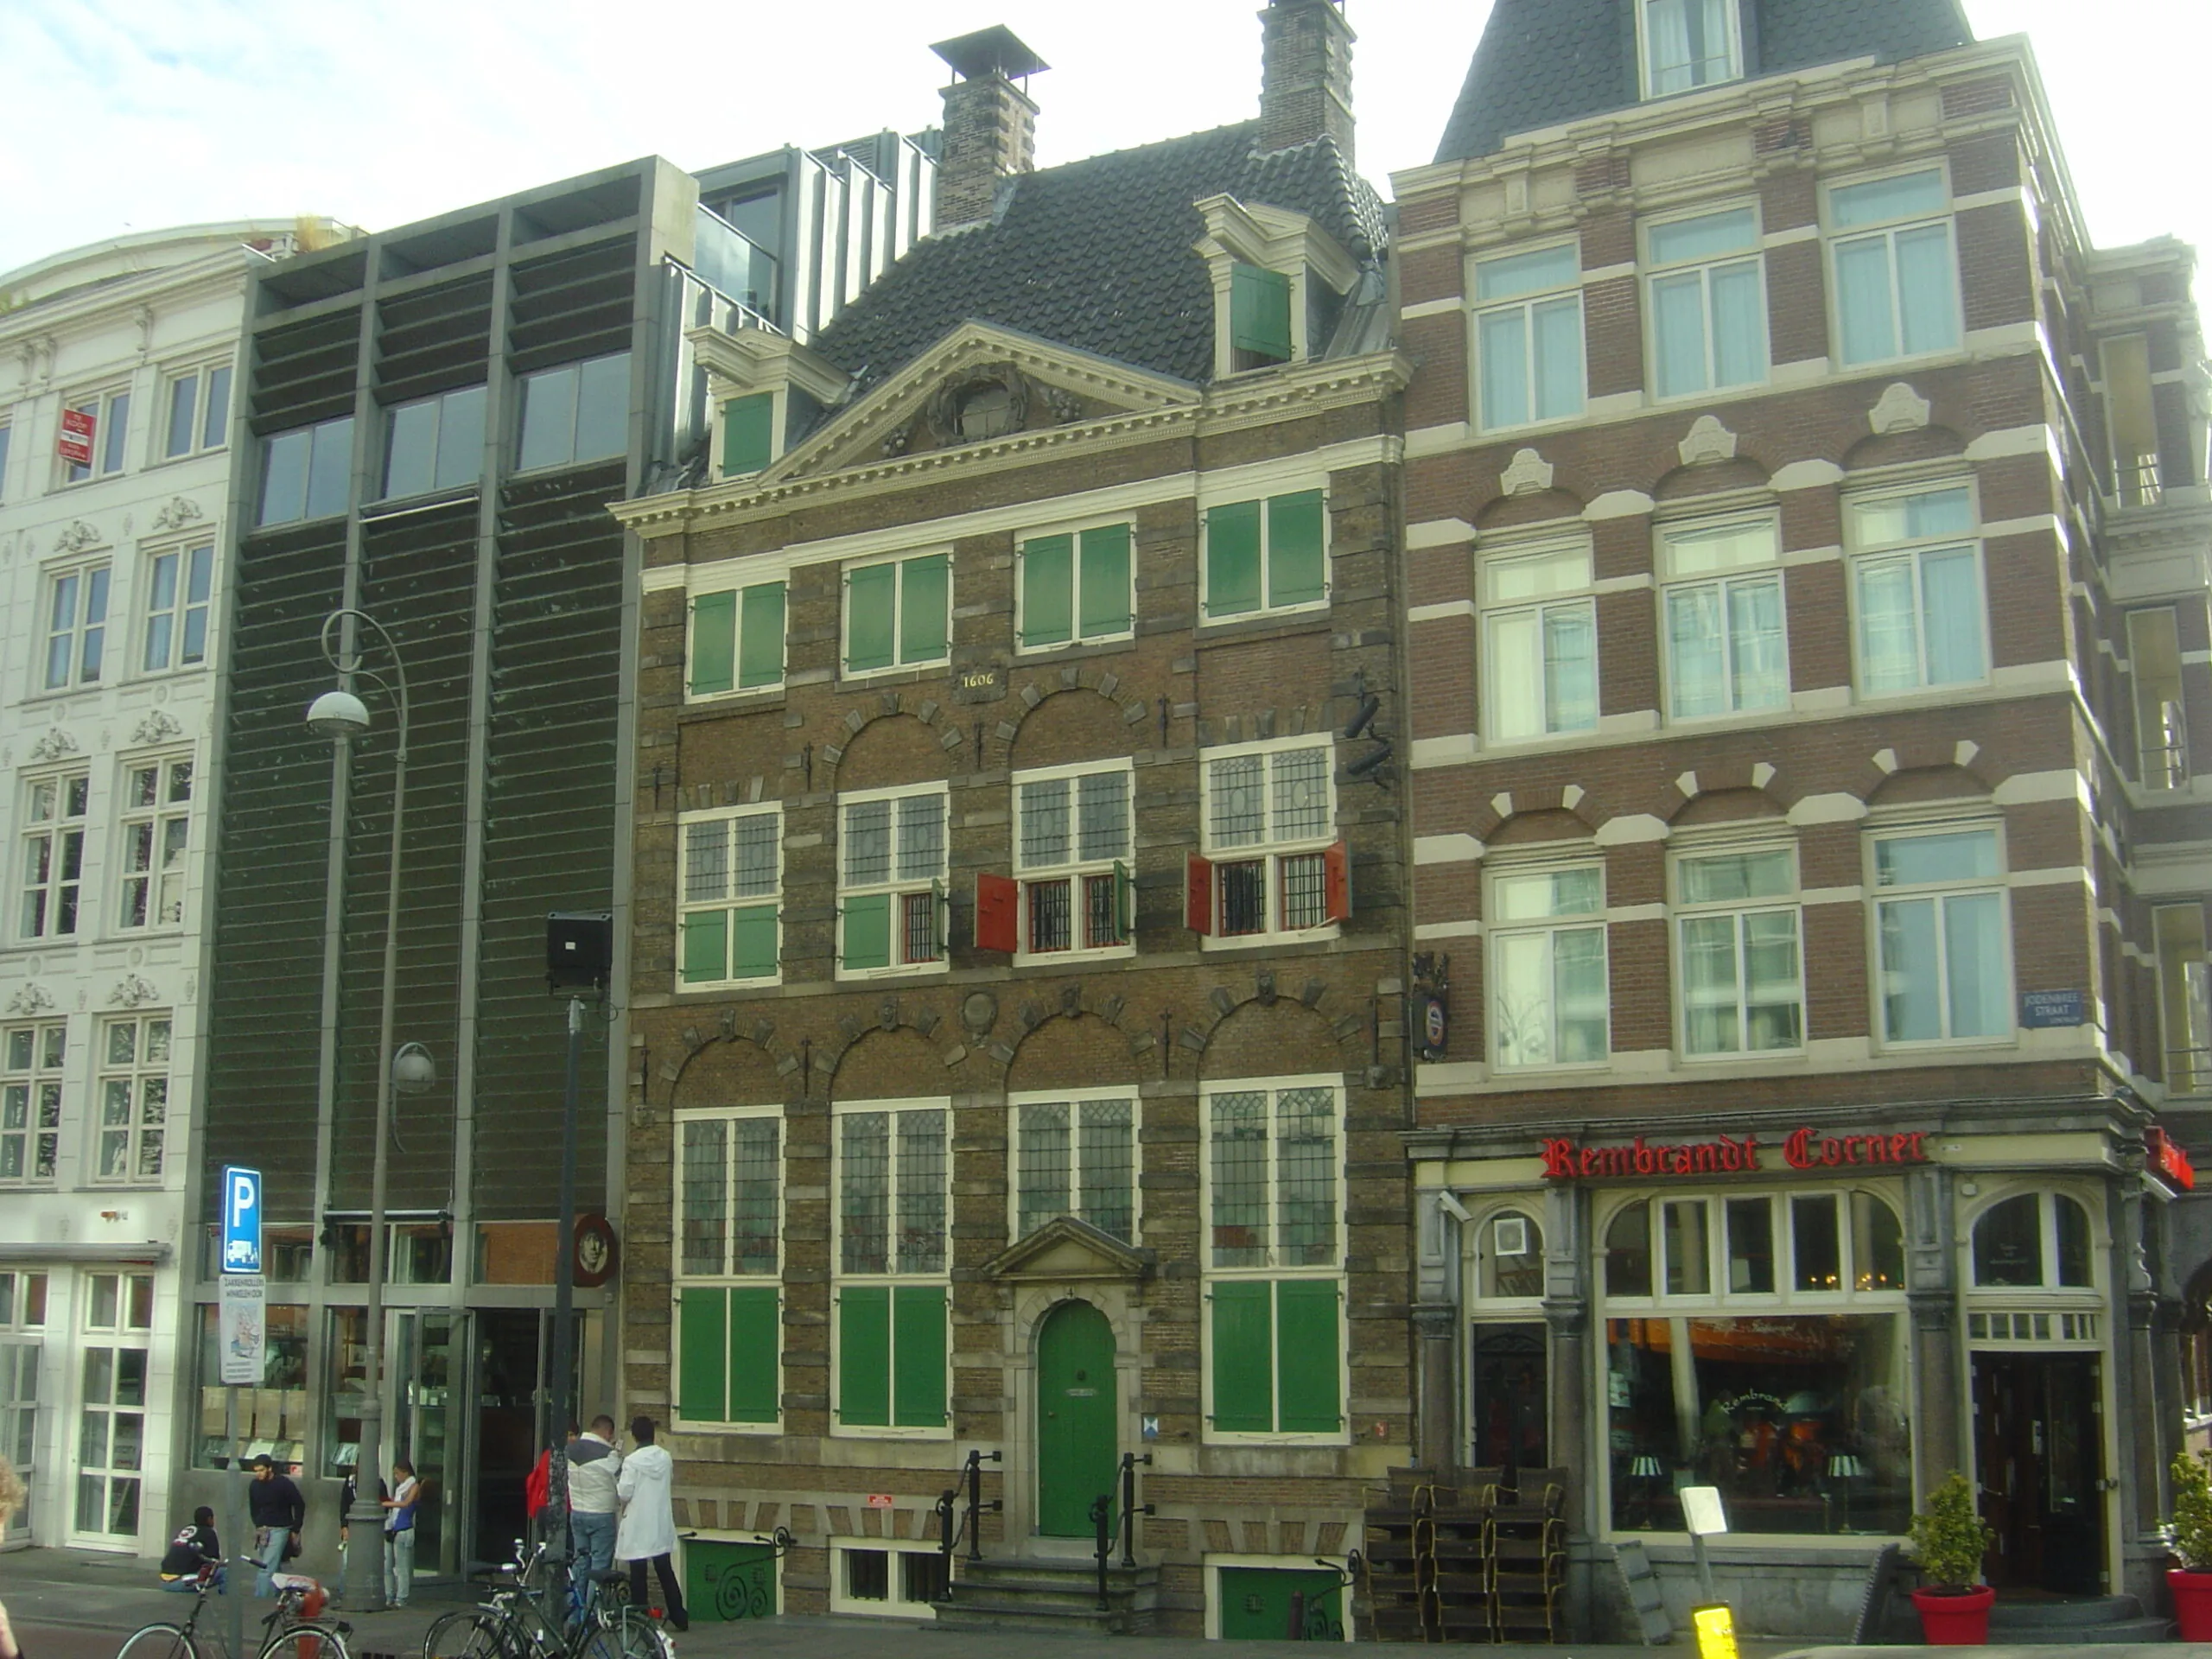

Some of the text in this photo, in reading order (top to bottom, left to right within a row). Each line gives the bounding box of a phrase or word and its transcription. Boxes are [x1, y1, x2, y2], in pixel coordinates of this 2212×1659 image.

[964, 673, 994, 688] 1606
[2035, 1004, 2069, 1017] STRAAT
[1541, 1125, 1929, 1178] Rembrandt Corner
[232, 1176, 255, 1228] P
[1066, 1287, 1074, 1298] 4
